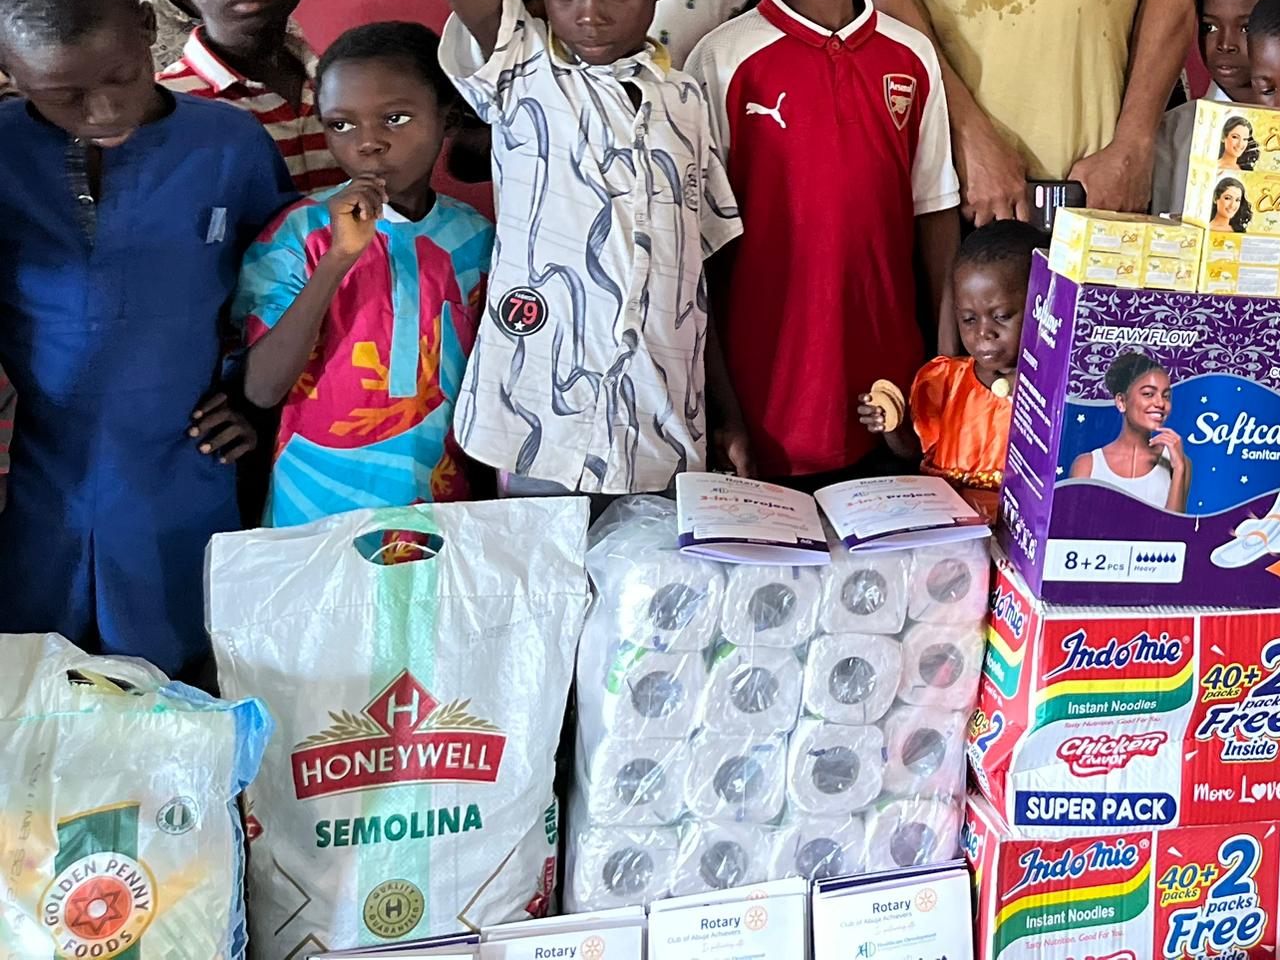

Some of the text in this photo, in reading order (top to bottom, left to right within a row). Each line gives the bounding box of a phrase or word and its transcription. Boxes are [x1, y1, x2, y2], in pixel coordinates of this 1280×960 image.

[889, 81, 913, 93] Arsenal
[508, 297, 538, 325] 79
[1091, 325, 1198, 346] HEAVY FLOW
[744, 498, 796, 512] Project
[886, 491, 937, 500] Project
[1107, 563, 1125, 571] PCS
[1133, 565, 1158, 573] Heavy
[1042, 629, 1182, 680] Indomie
[1206, 686, 1241, 701] packs
[386, 688, 420, 729] H
[1067, 698, 1157, 715] Instant Noodles
[1060, 732, 1166, 756] Chicken
[1223, 738, 1278, 758] Inside
[301, 741, 492, 787] HONEYWELL
[1193, 782, 1235, 803] More
[1025, 796, 1167, 822] SUPER PACK
[315, 803, 483, 848] SEMOLINA
[1001, 840, 1140, 901] Indomie
[45, 858, 149, 926] GOLDEN PENNY
[373, 882, 415, 900] QUALITY
[1161, 887, 1199, 904] packs
[385, 897, 403, 919] H
[872, 897, 911, 915] Rotary
[1206, 895, 1253, 913] packs
[369, 907, 419, 934] GUARANTEED
[700, 914, 741, 931] Rotary
[1026, 905, 1116, 929] Instant Noodles
[1166, 908, 1263, 954] Free
[63, 929, 133, 958] FOODS
[534, 944, 577, 960] Rotary
